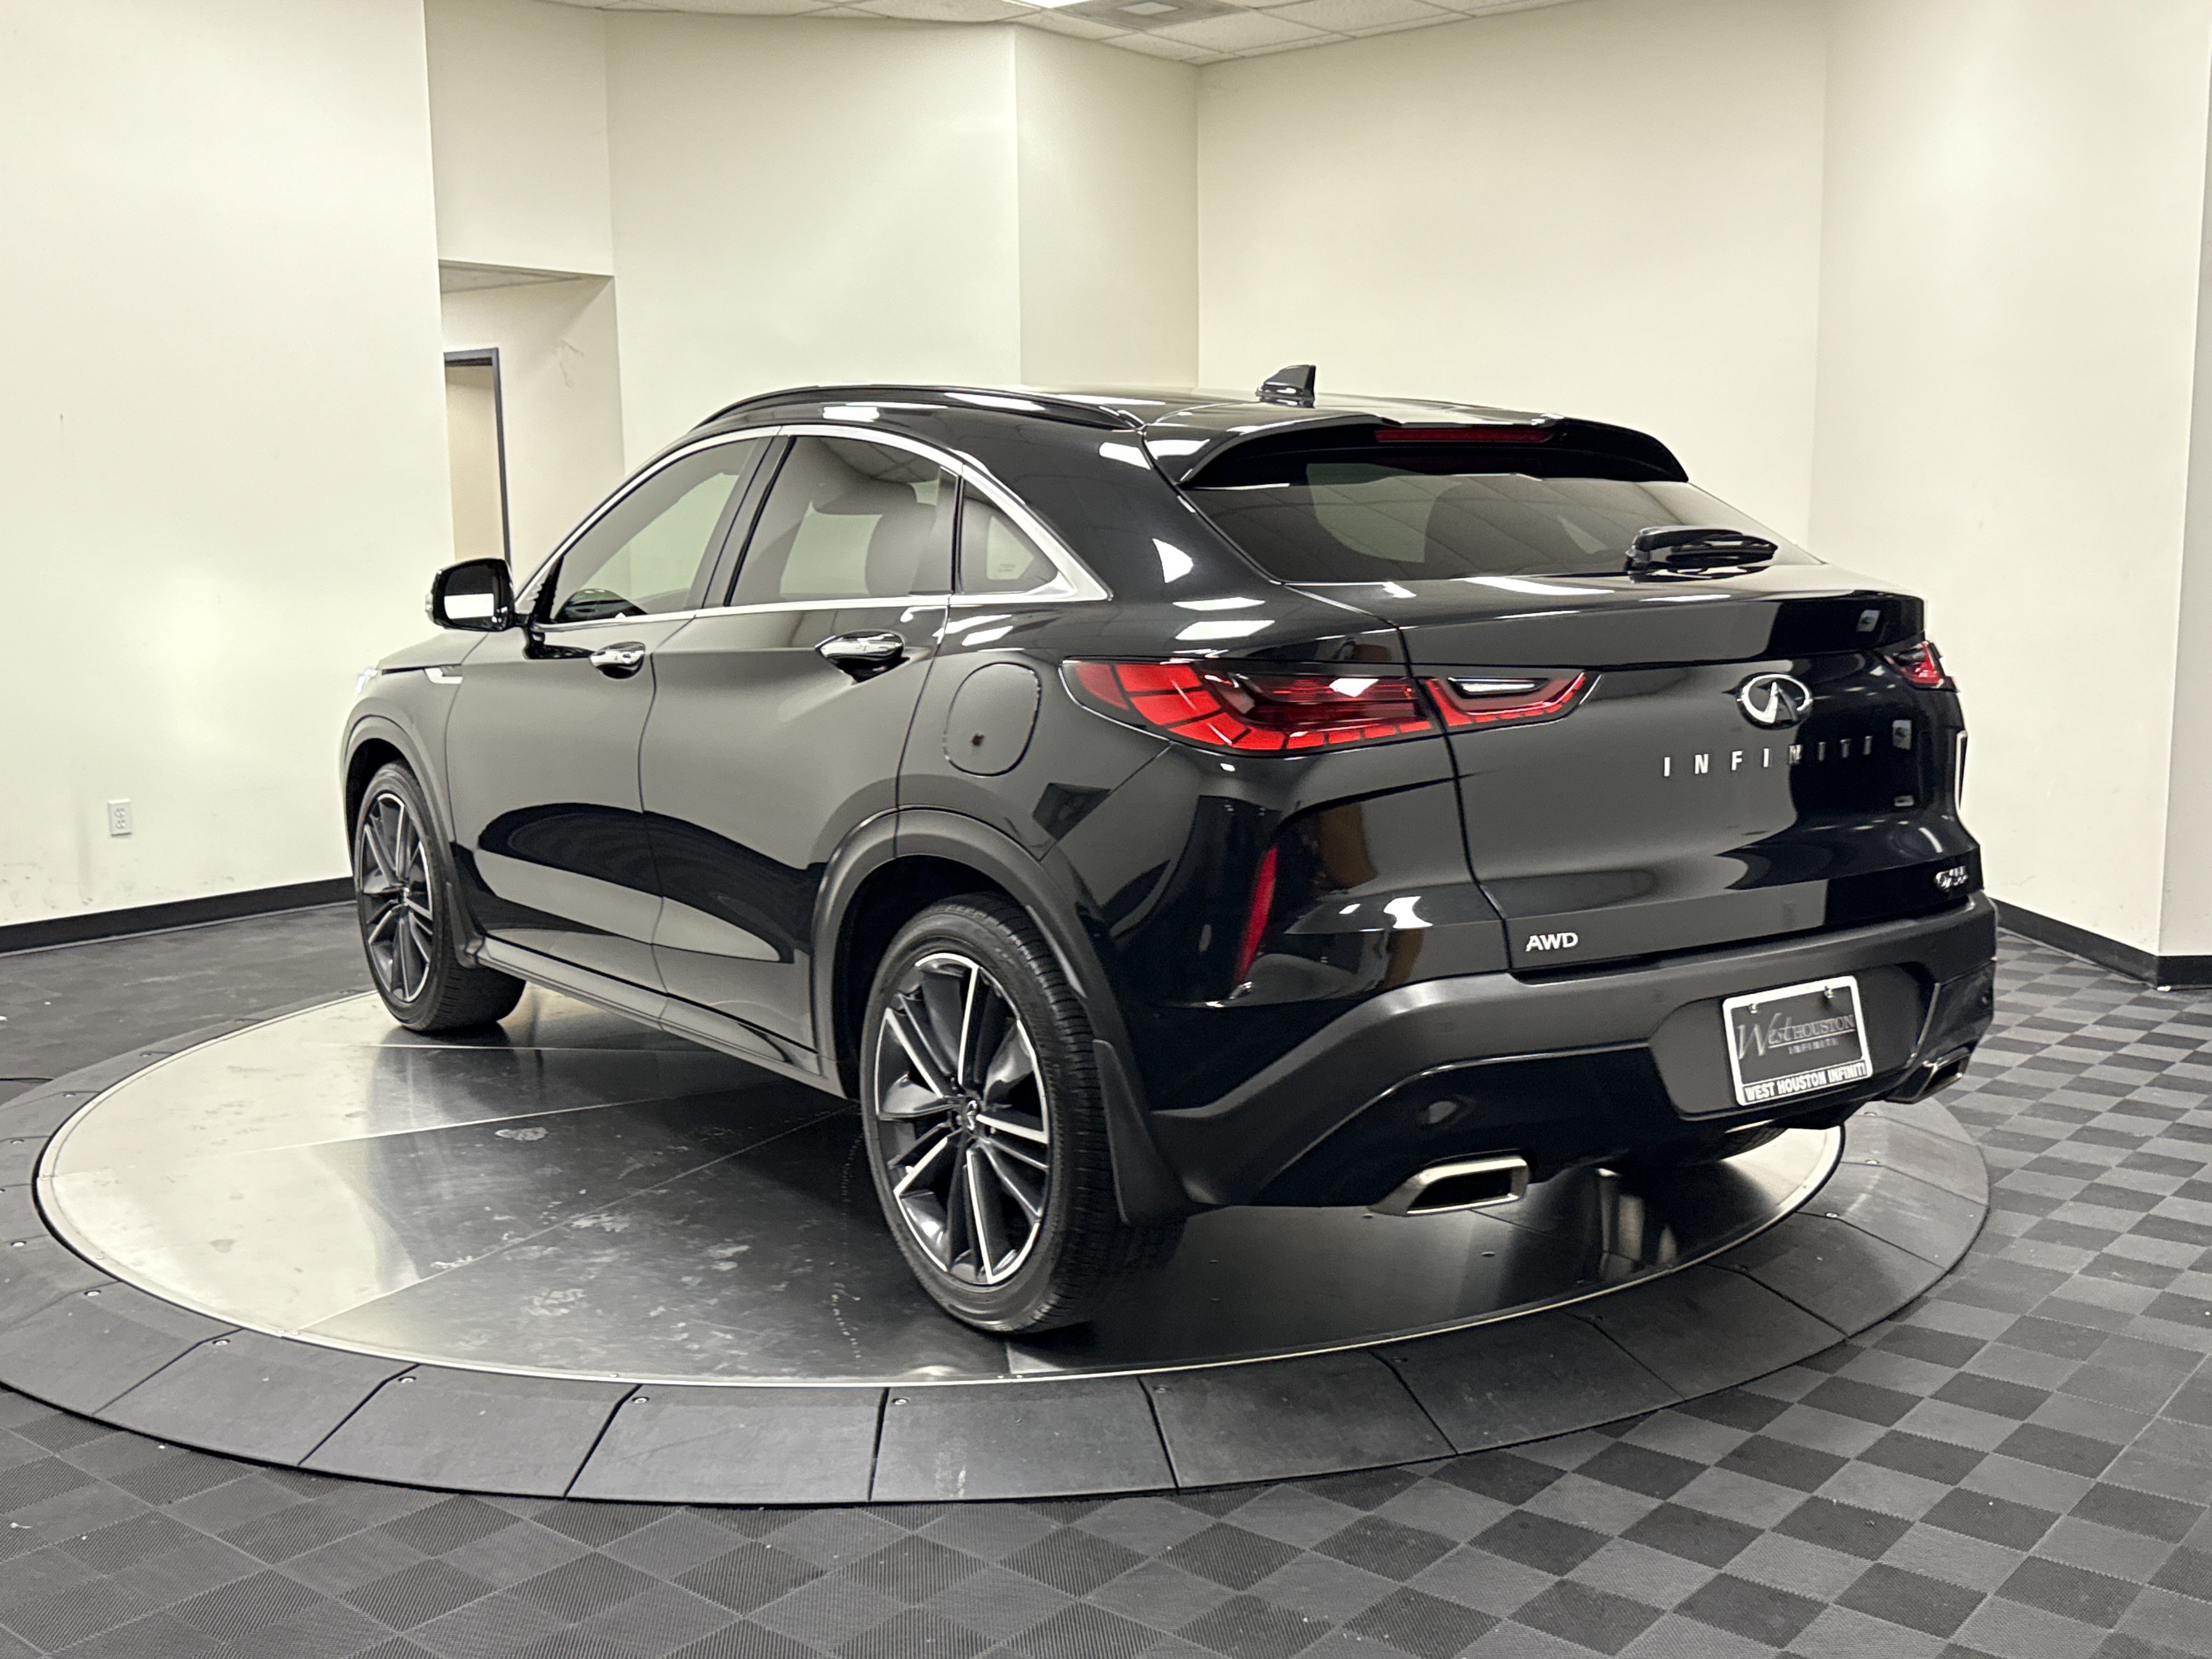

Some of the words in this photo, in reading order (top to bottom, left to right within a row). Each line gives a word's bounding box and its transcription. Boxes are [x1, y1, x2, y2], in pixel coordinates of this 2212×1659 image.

[1663, 735, 1873, 777] INFINITI
[1525, 932, 1578, 952] AWD
[1744, 1082, 1775, 1101] WEST
[1776, 1070, 1827, 1094] HOUSTON
[1827, 1062, 1866, 1083] INFINITI
